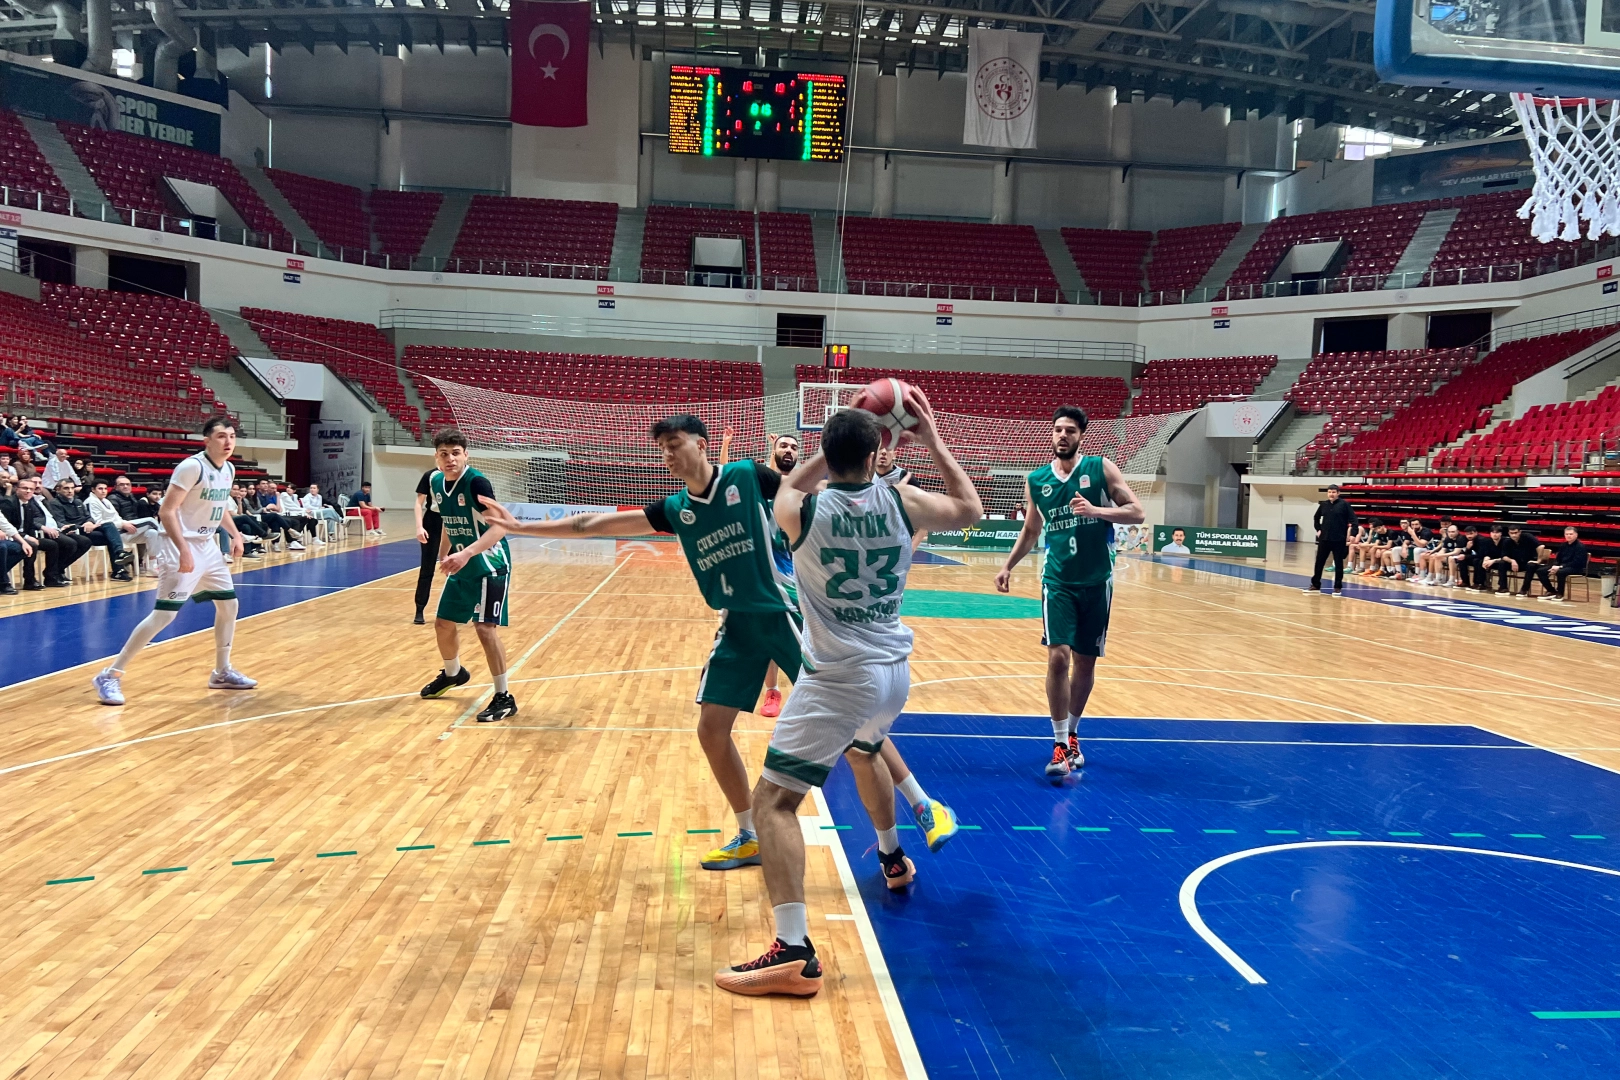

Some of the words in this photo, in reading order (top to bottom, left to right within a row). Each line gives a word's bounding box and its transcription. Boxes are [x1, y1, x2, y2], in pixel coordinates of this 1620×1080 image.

[116, 94, 157, 120] SPOR
[118, 114, 144, 136] HER
[149, 121, 194, 146] YERDE
[1460, 174, 1499, 184] ADAMLAR
[834, 354, 846, 367] 17
[210, 506, 223, 521] 10
[1048, 504, 1074, 518] ÇUKUR
[1069, 536, 1078, 555] 9
[820, 546, 902, 600] 23
[720, 573, 734, 596] 4
[493, 601, 500, 617] 0
